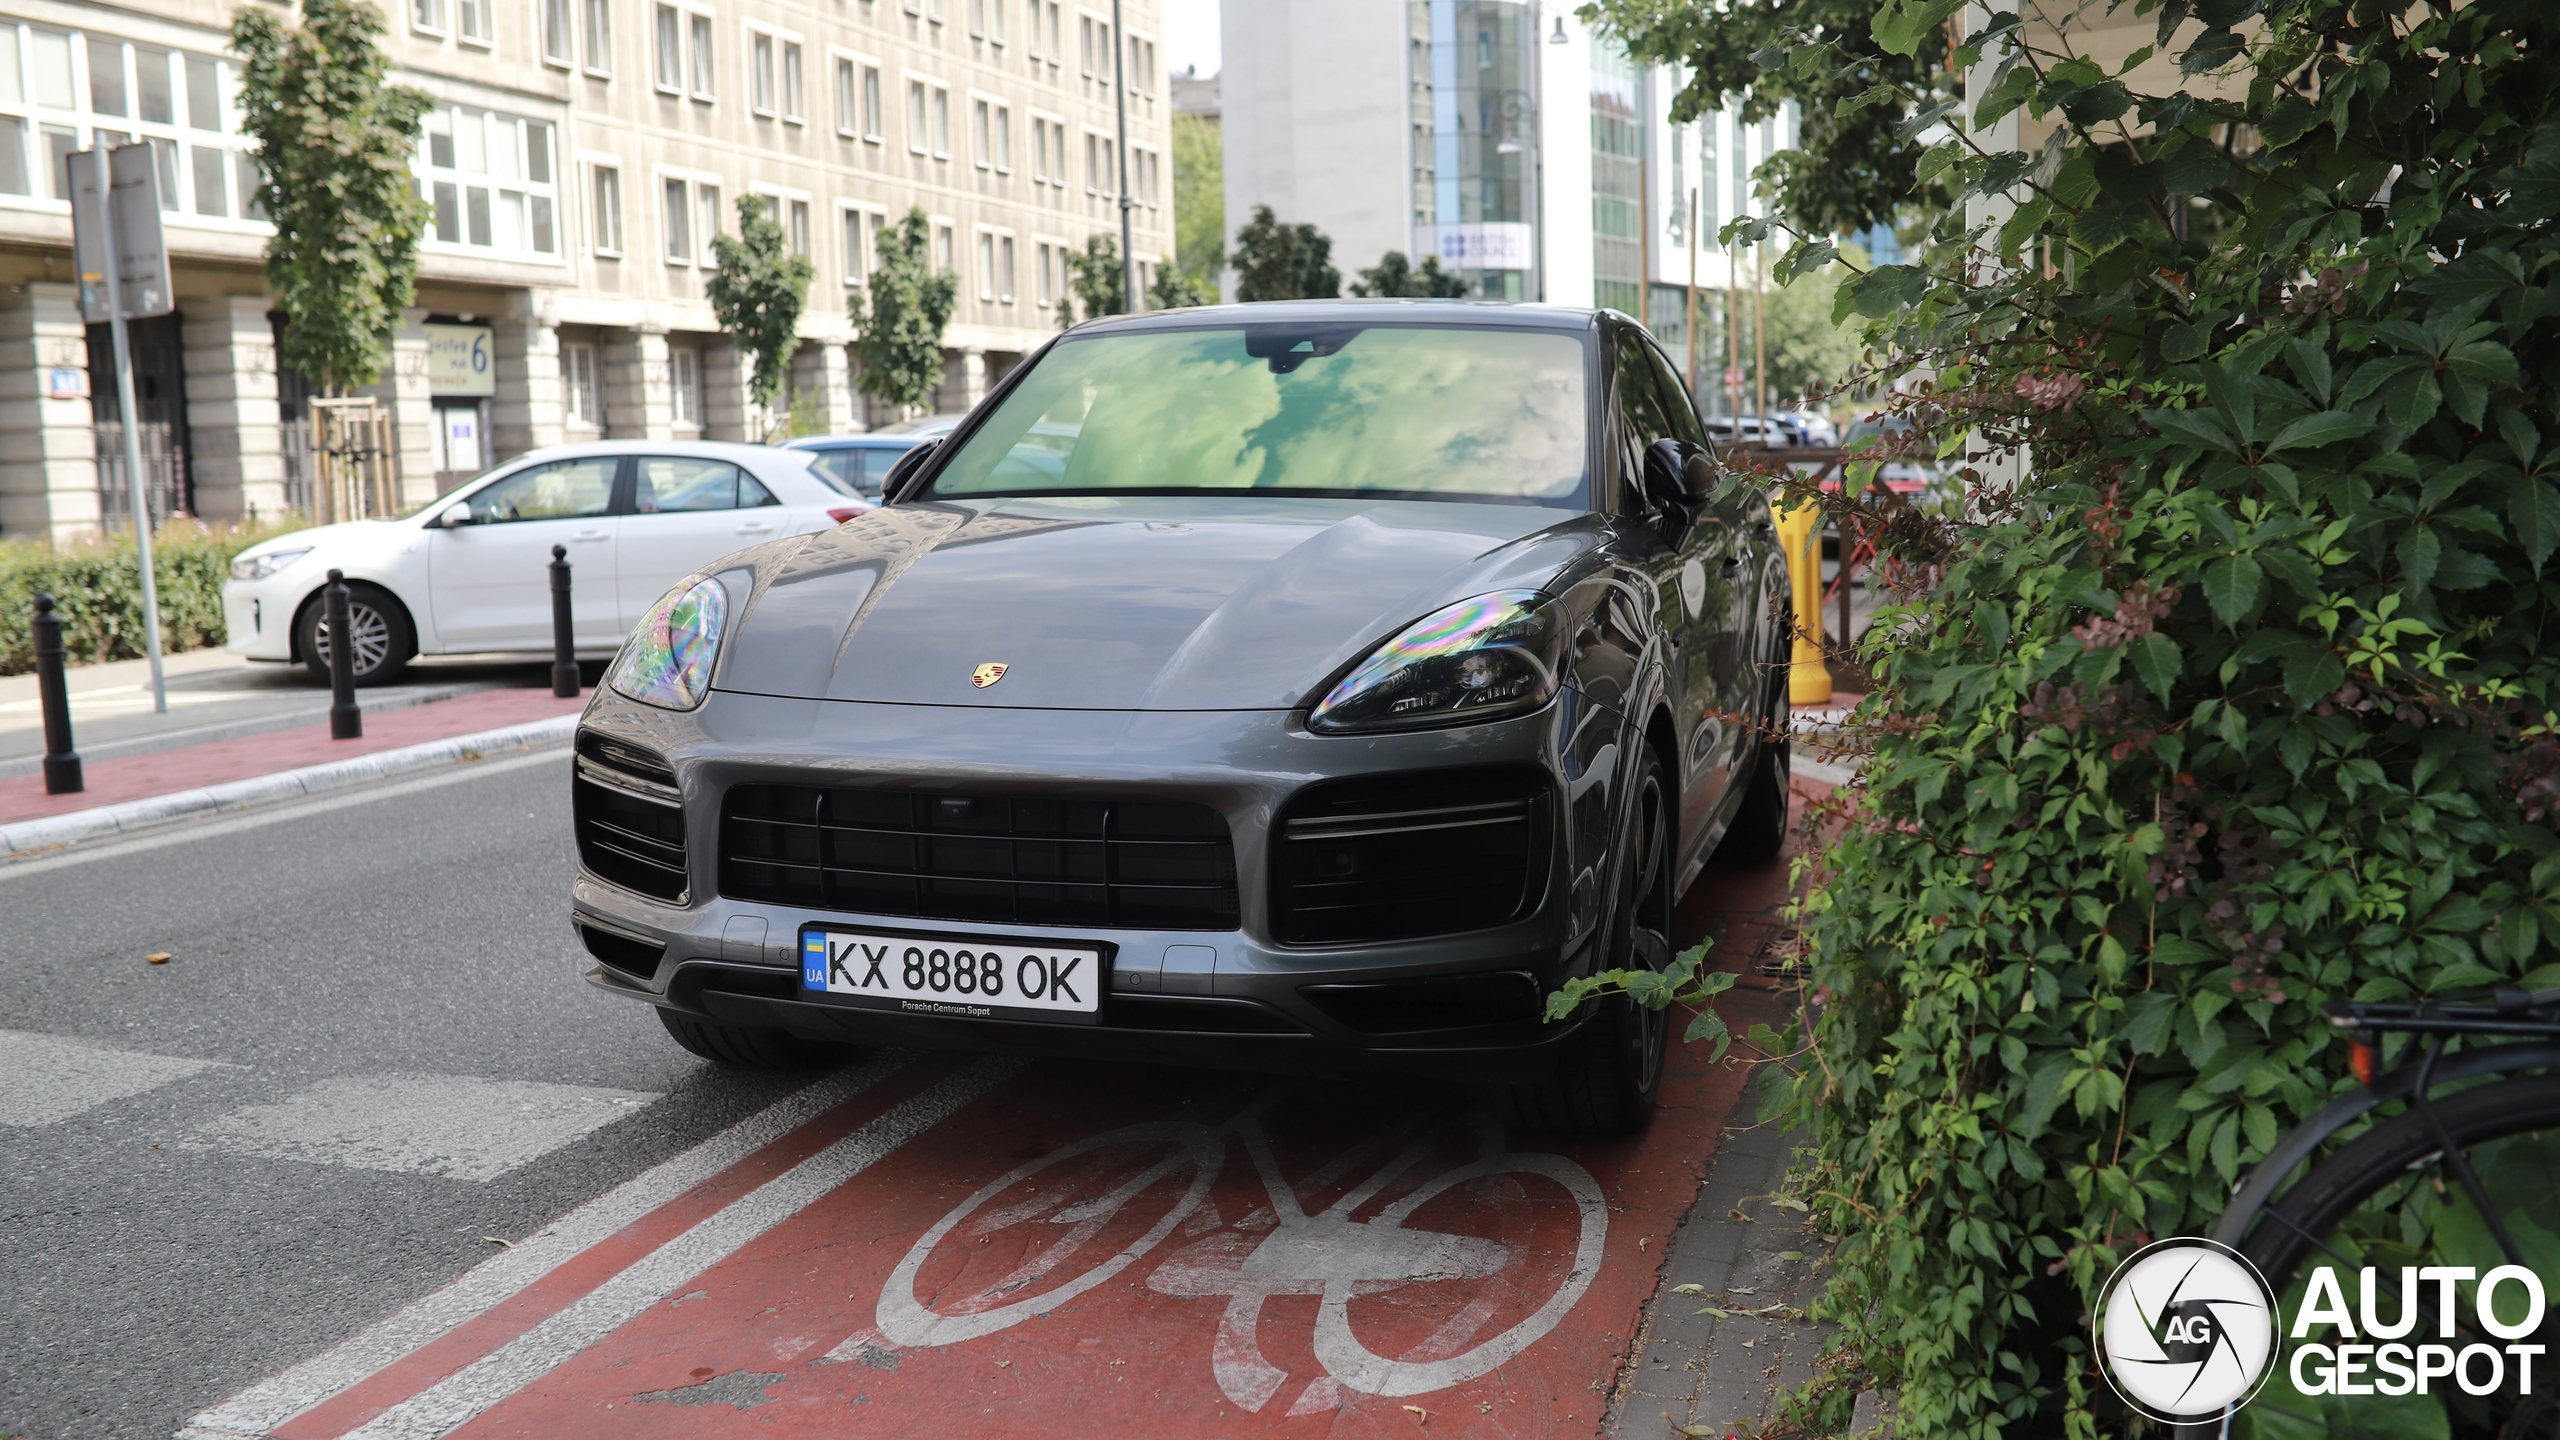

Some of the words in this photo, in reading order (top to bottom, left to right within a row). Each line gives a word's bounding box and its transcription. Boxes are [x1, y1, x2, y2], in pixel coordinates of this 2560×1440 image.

[472, 332, 487, 374] 6
[806, 968, 824, 983] UA
[829, 941, 889, 989] KX
[903, 946, 1003, 996] 8888
[1017, 954, 1082, 1003] OK
[902, 1000, 932, 1011] Porsche
[933, 1003, 966, 1014] Centrum
[967, 1005, 990, 1016] Sopot
